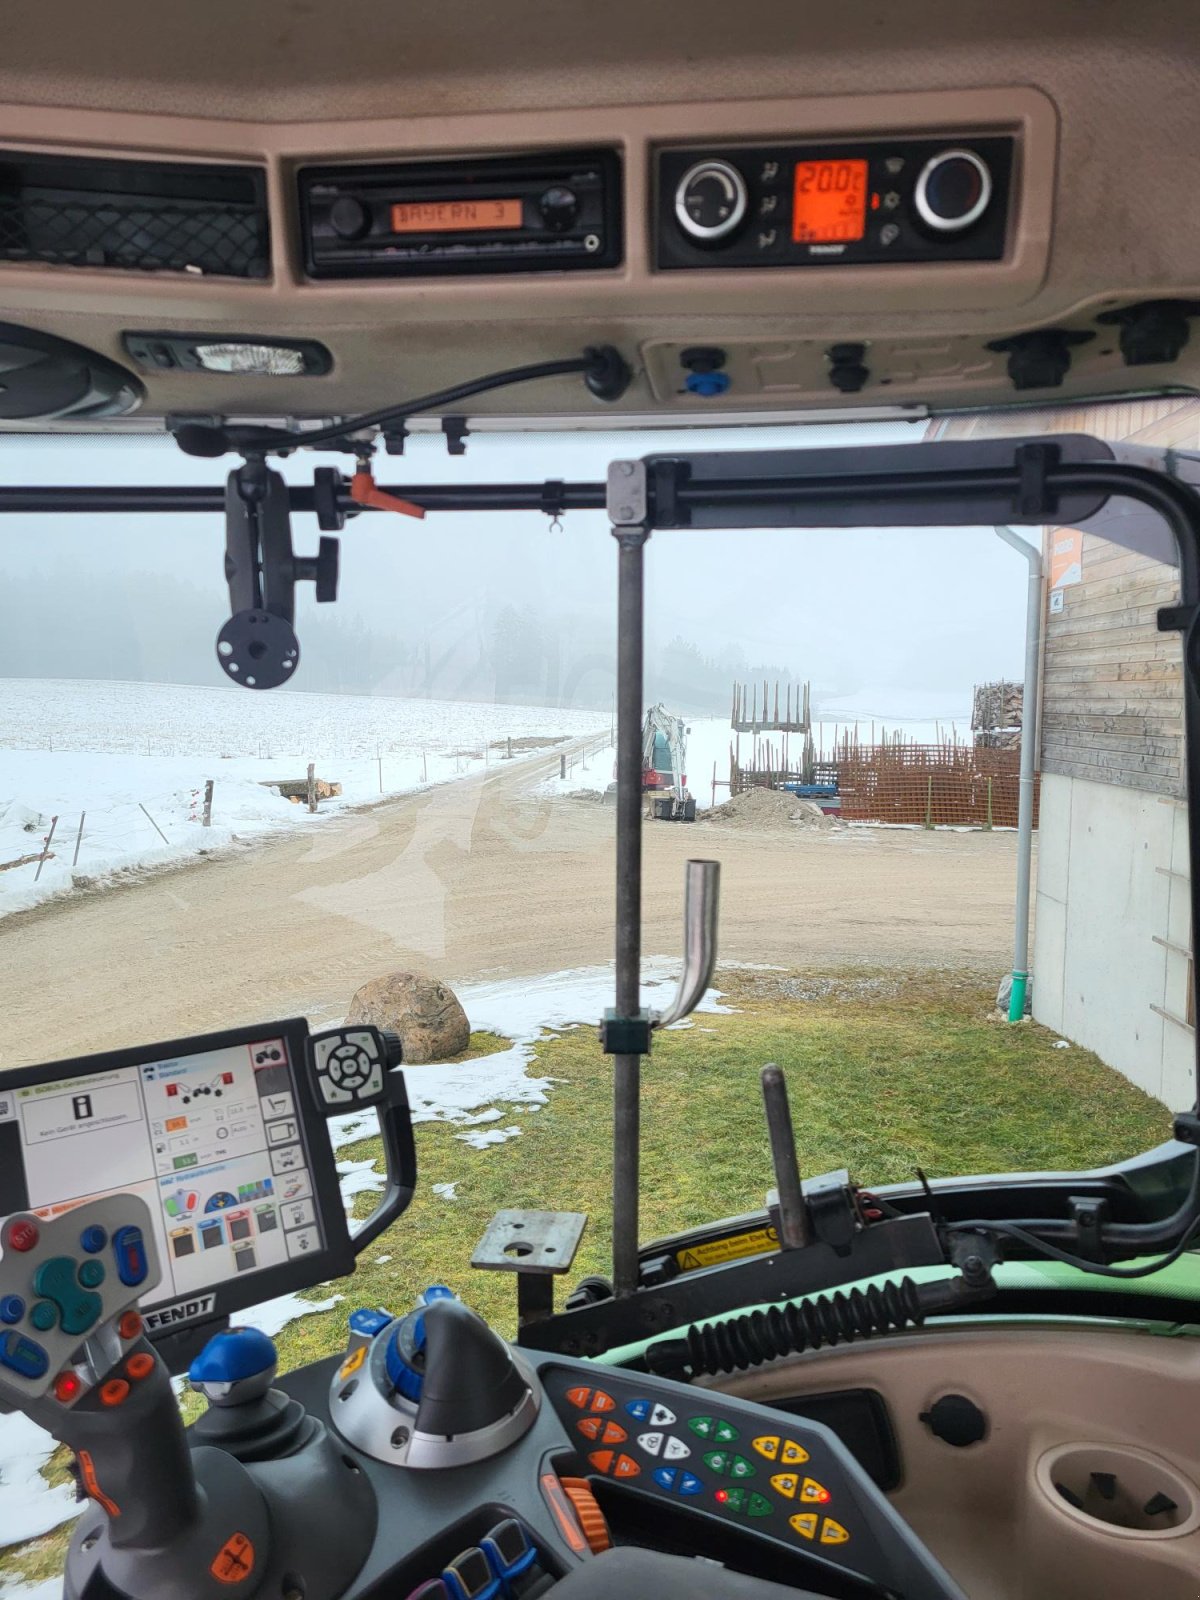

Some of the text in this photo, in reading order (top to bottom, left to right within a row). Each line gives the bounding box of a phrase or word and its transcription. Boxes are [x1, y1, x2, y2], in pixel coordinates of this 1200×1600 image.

[399, 202, 505, 222] BAYERN 3
[145, 1297, 213, 1329] FENDT
